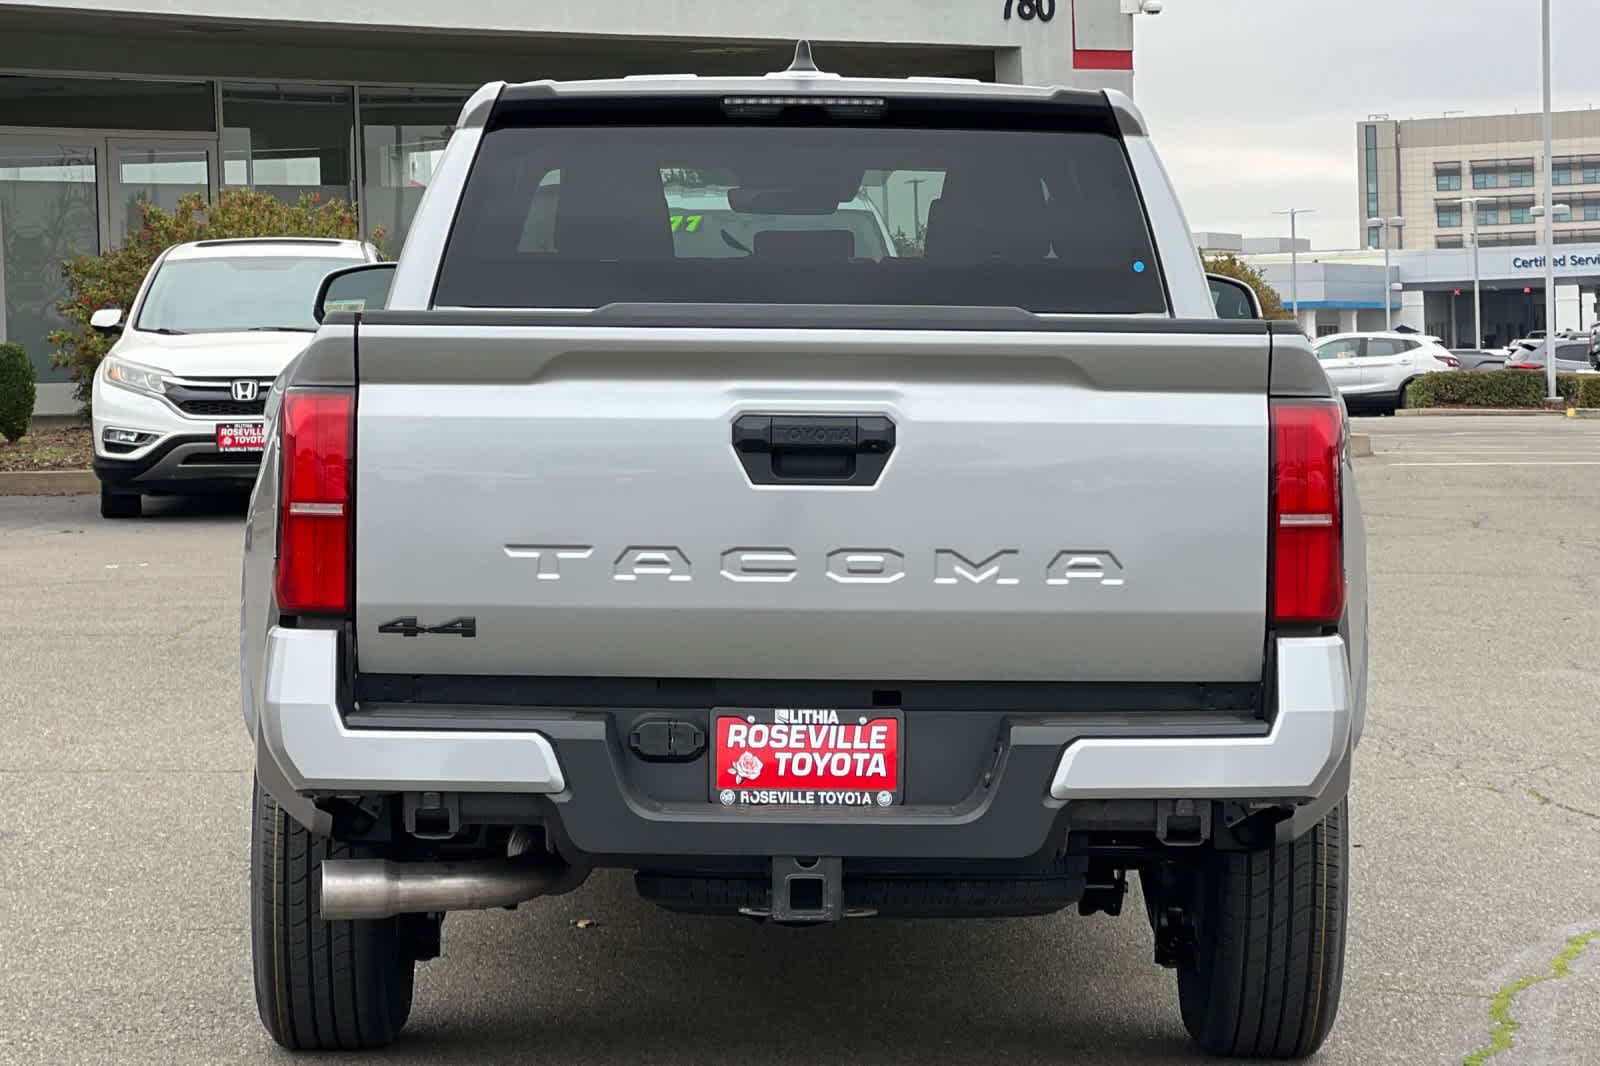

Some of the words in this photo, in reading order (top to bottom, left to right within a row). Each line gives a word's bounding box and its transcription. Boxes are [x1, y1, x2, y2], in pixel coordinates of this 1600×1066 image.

[1003, 0, 1056, 22] 780
[1512, 255, 1566, 269] Certied
[775, 427, 849, 442] TOYOTA
[503, 543, 1124, 586] TACOMA
[789, 709, 840, 725] LITHIA
[727, 723, 888, 750] ROSEVILLE
[774, 751, 888, 777] TOYOTA
[740, 790, 815, 805] ROSEVILLE
[818, 791, 872, 806] TOYOTA
